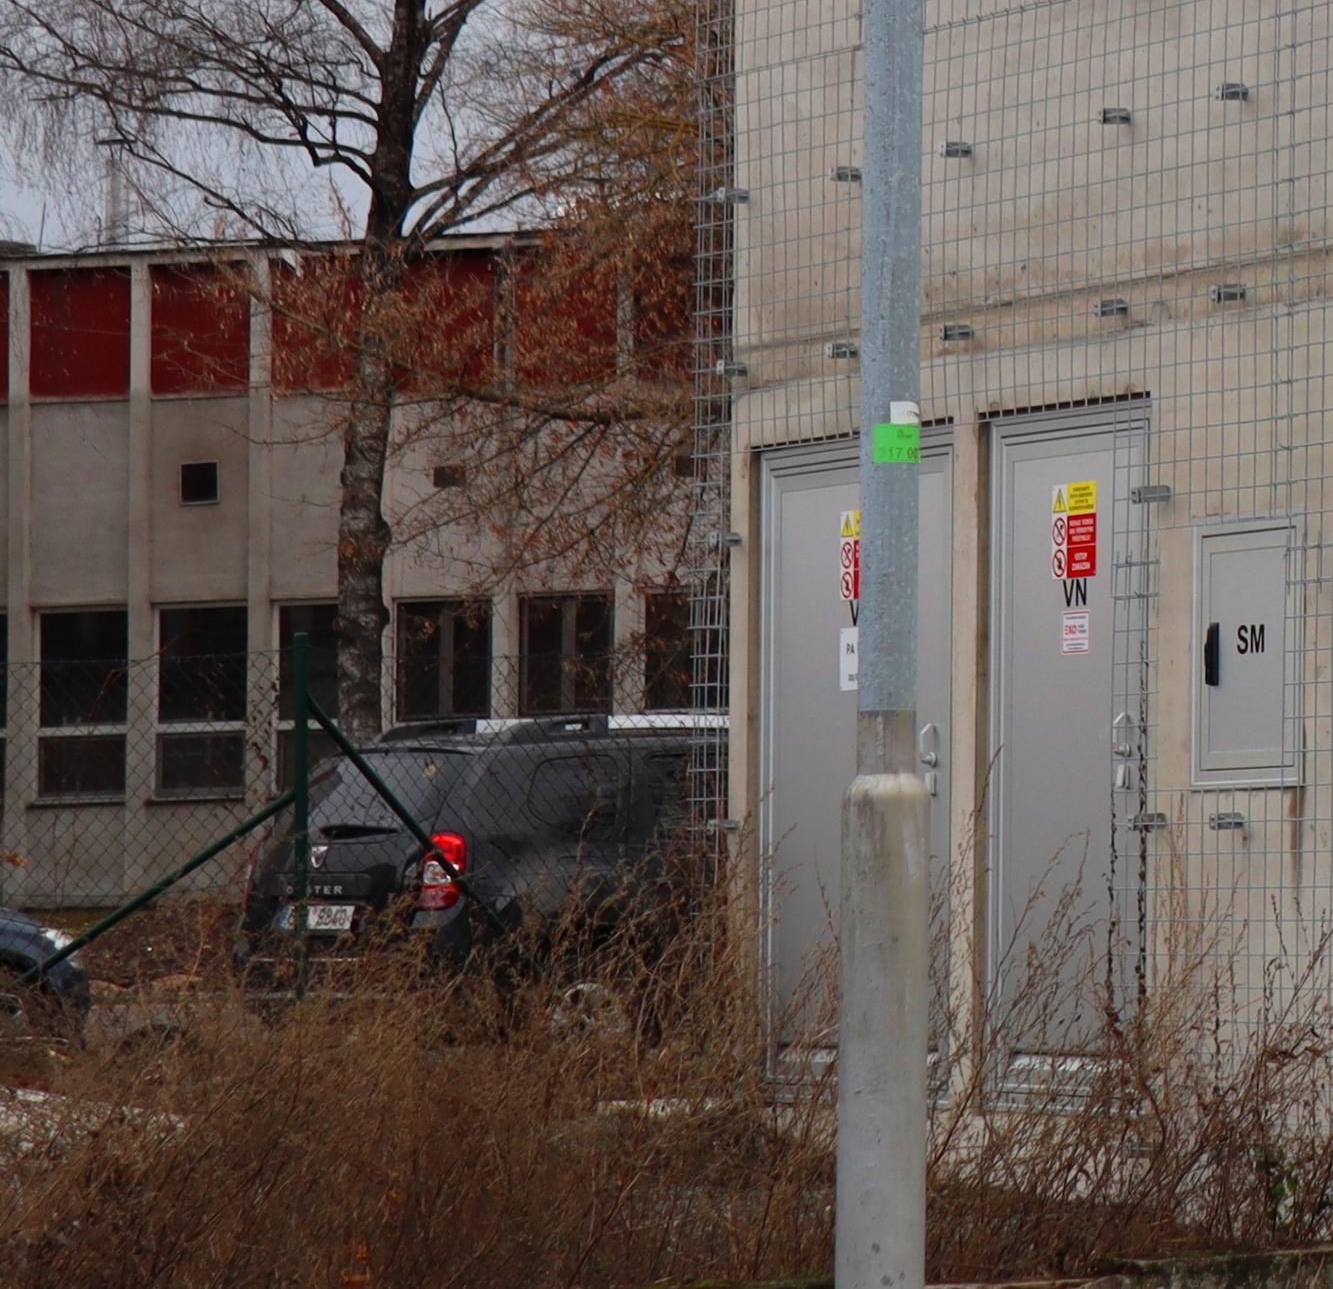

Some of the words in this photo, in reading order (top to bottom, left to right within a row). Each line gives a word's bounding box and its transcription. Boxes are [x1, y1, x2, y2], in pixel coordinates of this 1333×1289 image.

[1063, 578, 1087, 607] VN
[1237, 624, 1264, 654] SM
[286, 885, 343, 895] DTER
